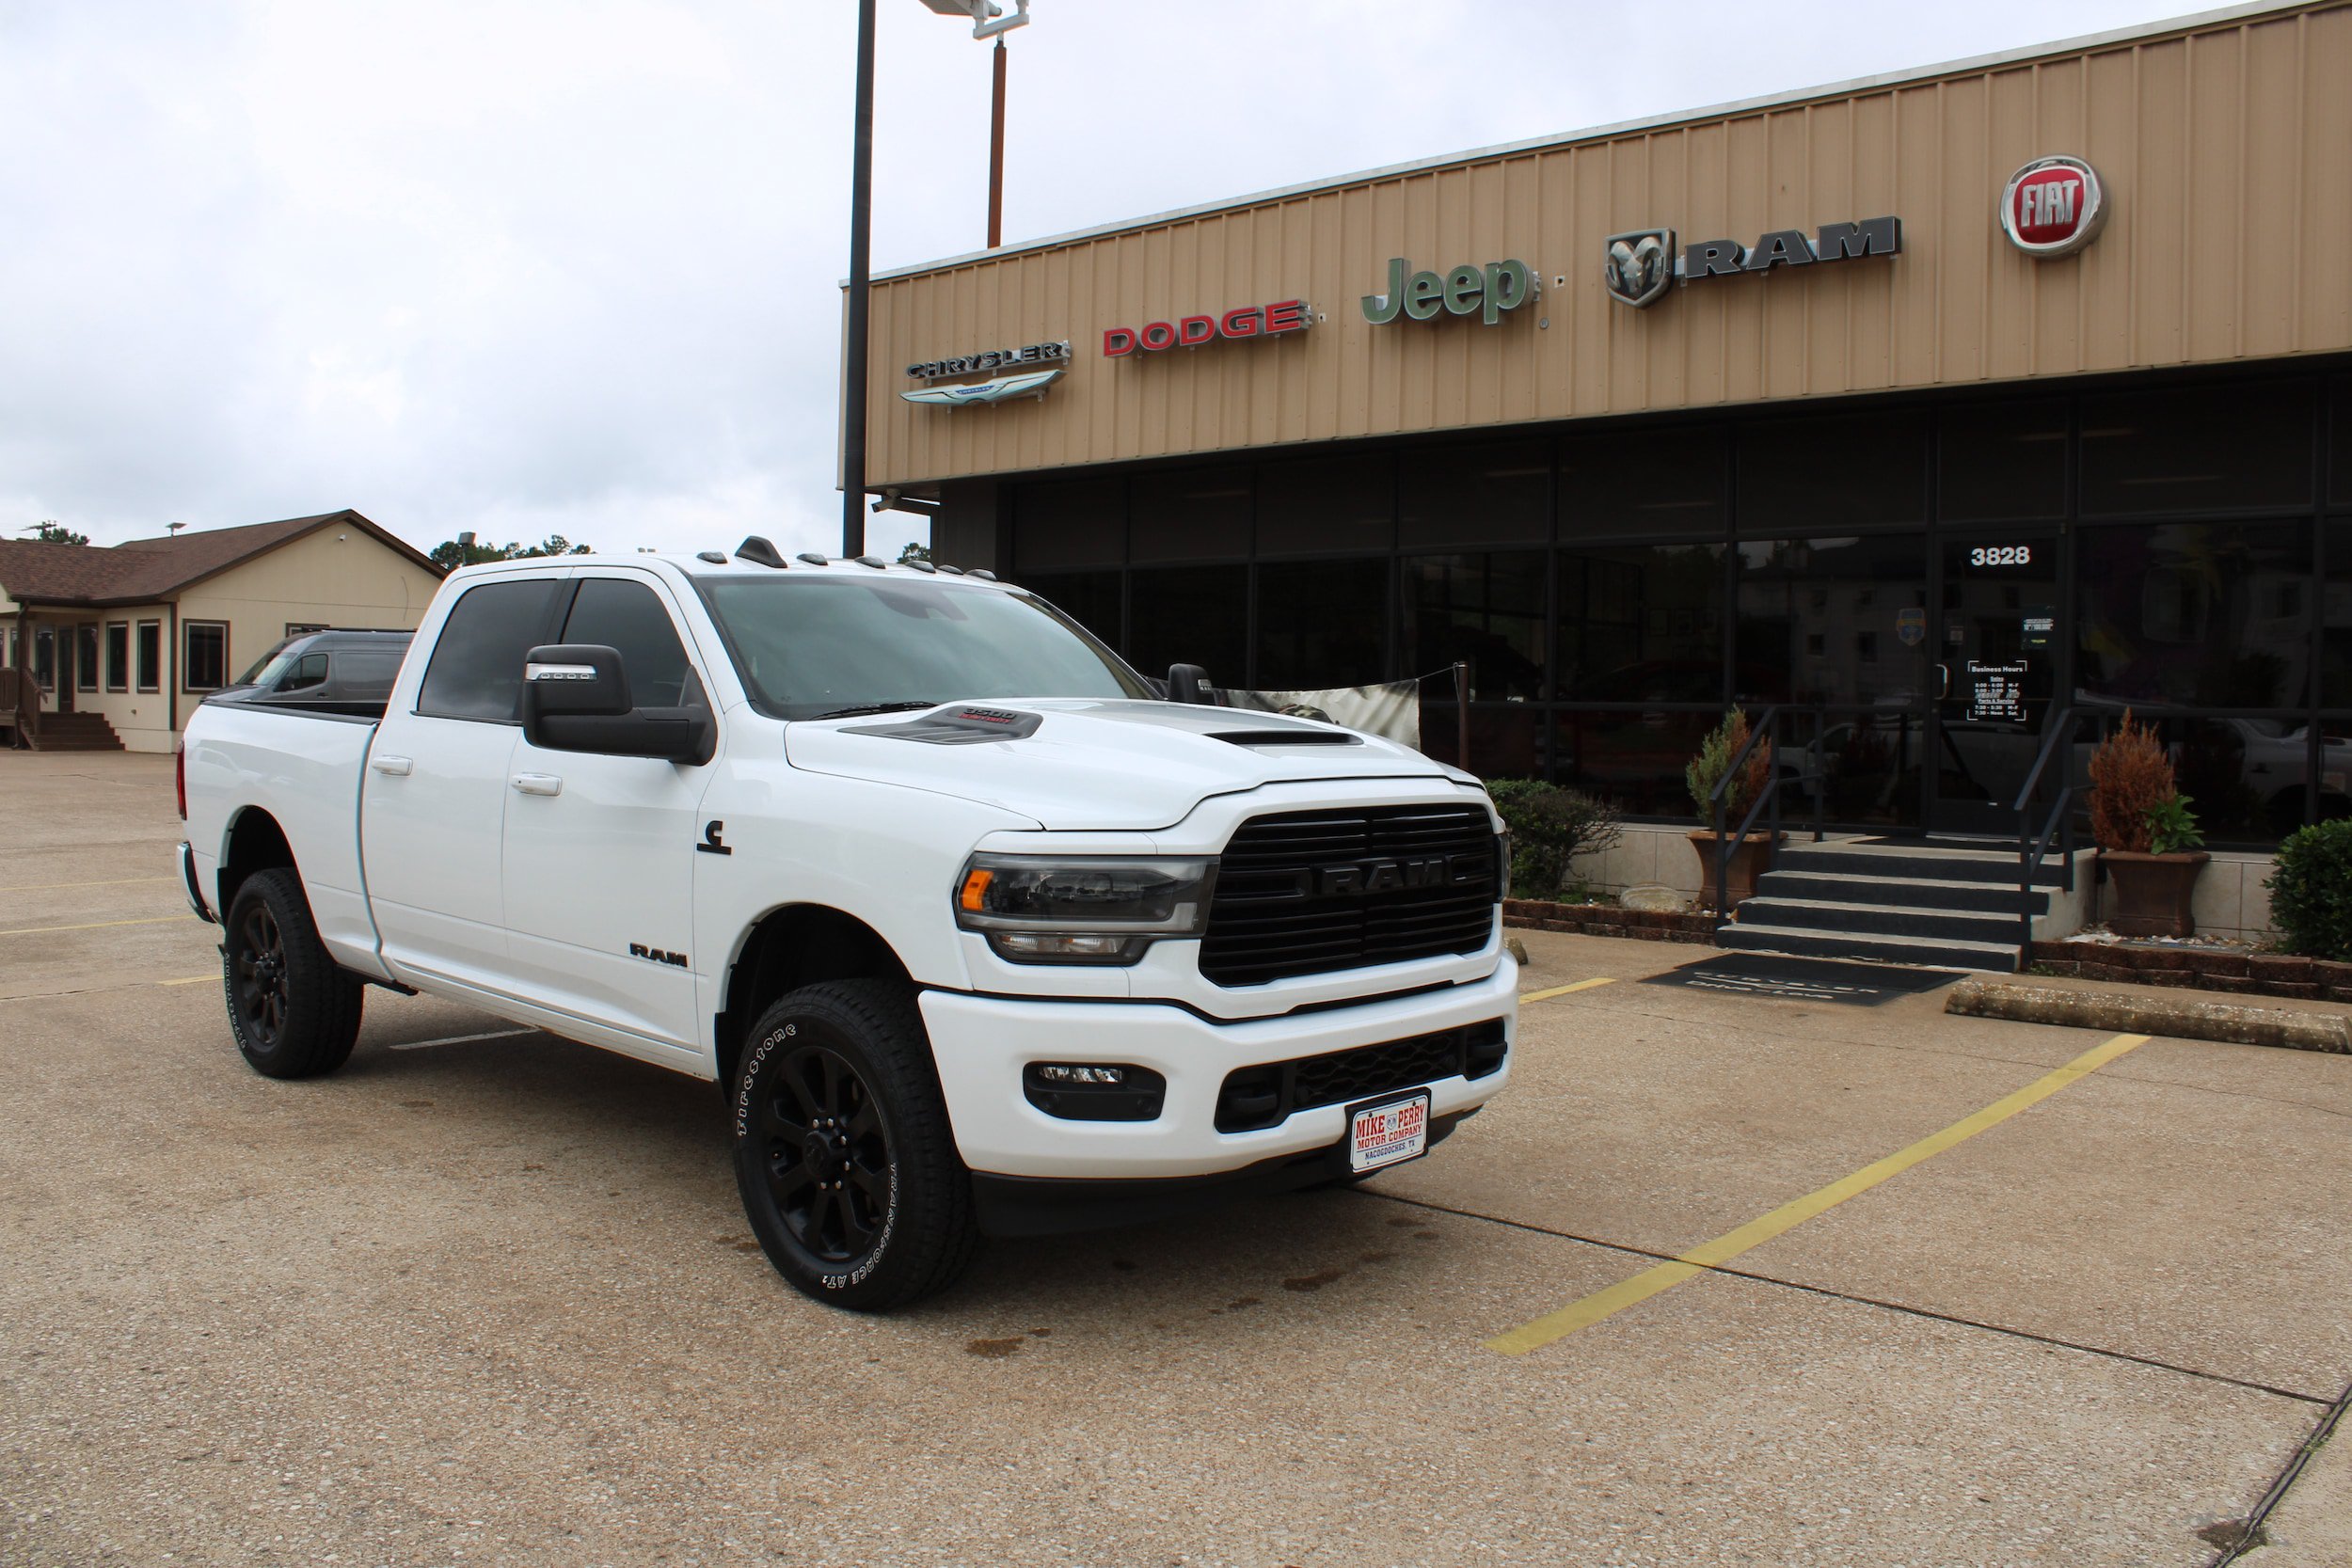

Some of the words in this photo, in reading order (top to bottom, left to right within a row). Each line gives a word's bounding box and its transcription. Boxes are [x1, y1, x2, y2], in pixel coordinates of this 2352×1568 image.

[2021, 178, 2080, 229] FIAT
[1685, 216, 1900, 279] RAM
[1360, 258, 1529, 325] Jeep
[1103, 298, 1306, 358] DODGE
[907, 341, 1064, 379] CHRYSLER
[1971, 546, 2031, 567] 3828
[1322, 860, 1444, 895] RAM
[629, 942, 688, 968] RAM
[737, 1023, 798, 1137] Firestone
[1356, 1115, 1386, 1140] MIKE
[1398, 1103, 1425, 1129] PERRY
[1357, 1133, 1386, 1149] MOTOR
[1389, 1124, 1422, 1142] COMPANY
[1408, 1139, 1415, 1148] TX
[850, 1162, 898, 1285] TRANSFORCE
